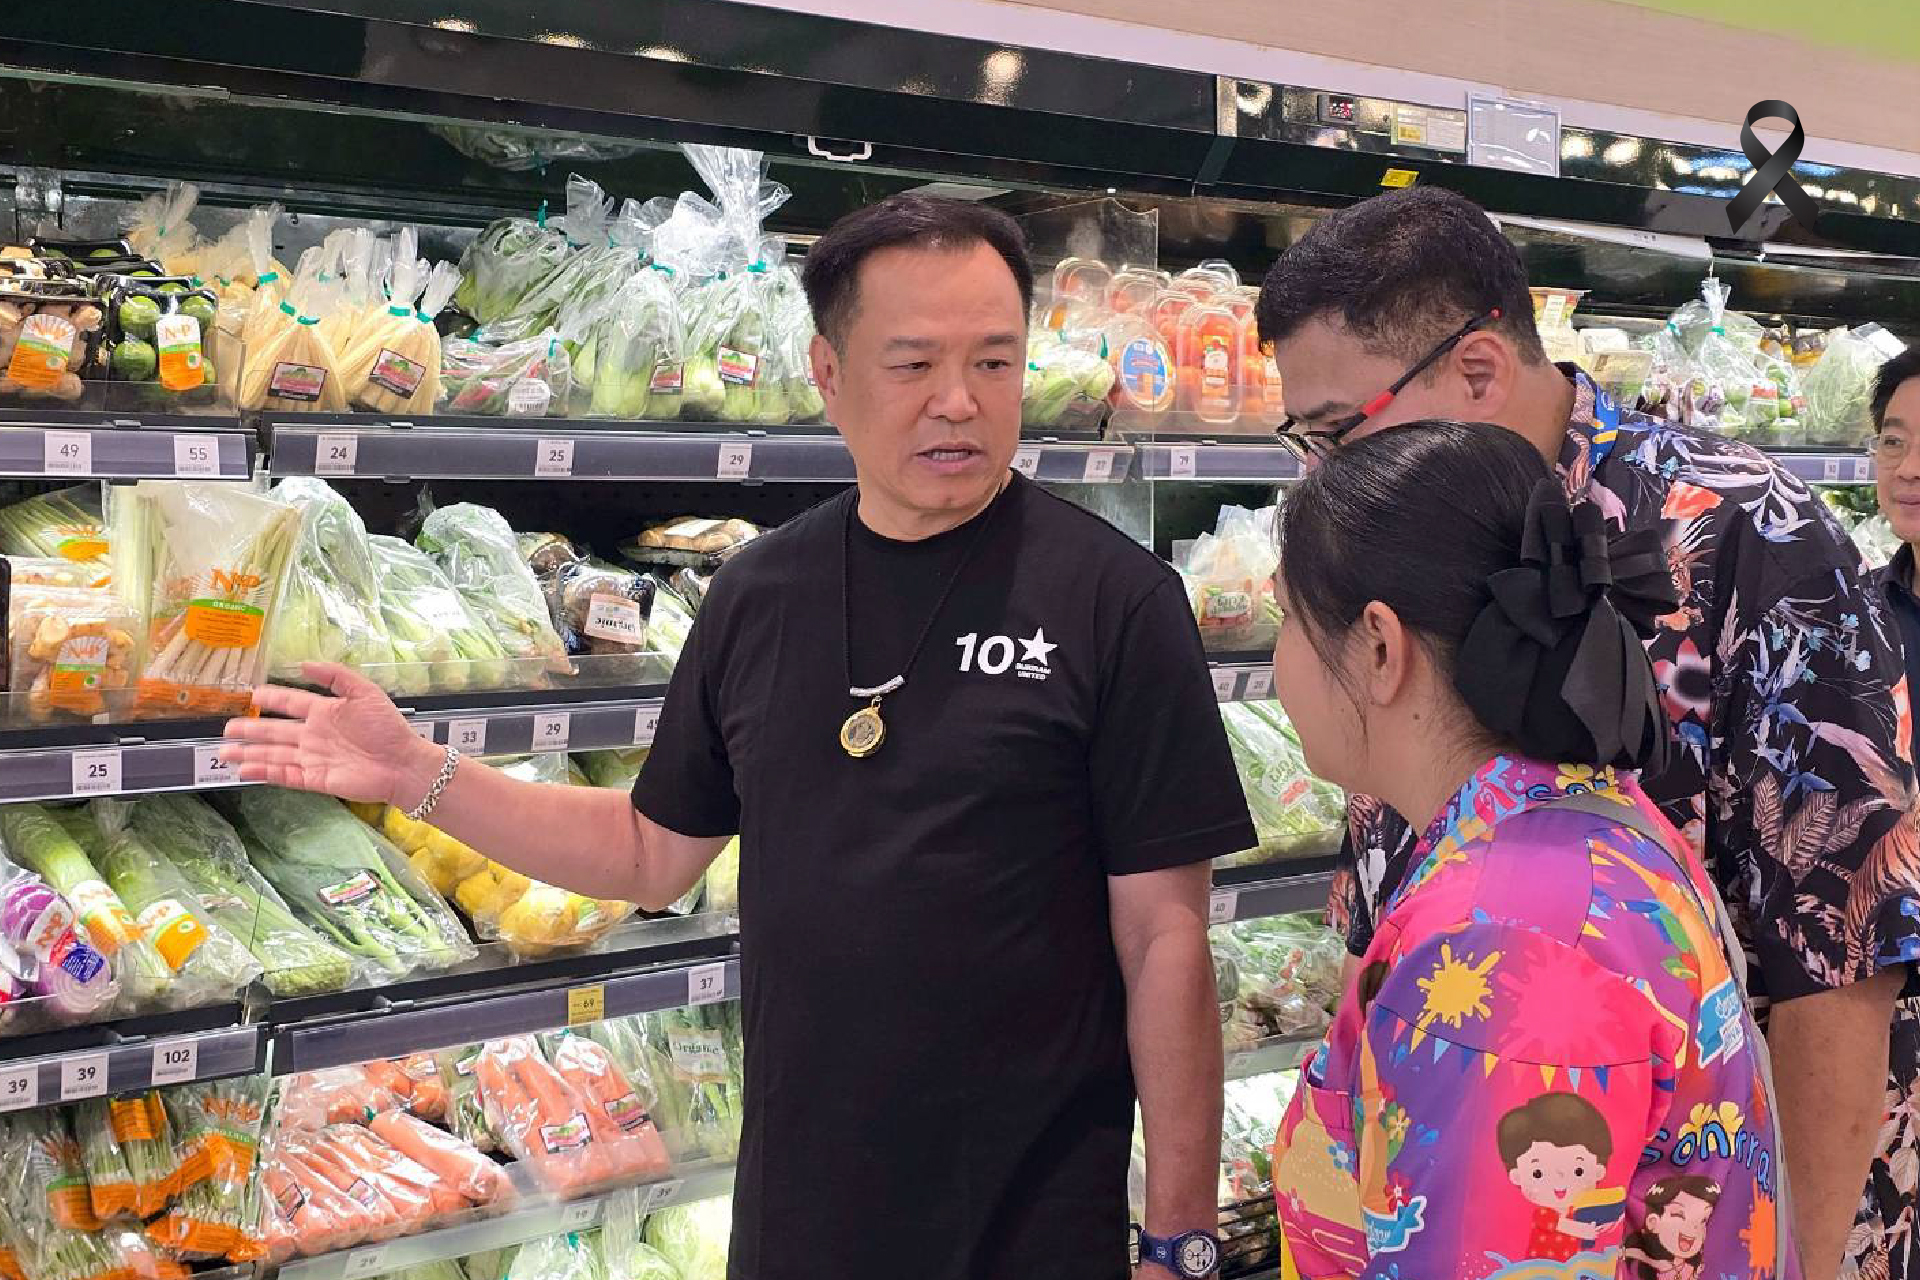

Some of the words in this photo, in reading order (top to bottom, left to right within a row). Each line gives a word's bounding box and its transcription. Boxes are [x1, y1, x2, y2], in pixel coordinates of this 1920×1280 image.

[60, 443, 80, 458] 49
[189, 447, 208, 461] 55
[330, 447, 348, 460] 24
[548, 449, 565, 463] 25
[729, 453, 745, 466] 29
[955, 632, 1015, 675] 10
[544, 723, 561, 736] 29
[461, 731, 478, 743] 33
[88, 763, 108, 777] 25
[699, 977, 714, 990] 37
[163, 1049, 191, 1065] 102
[77, 1066, 96, 1081] 39
[7, 1078, 28, 1094] 39
